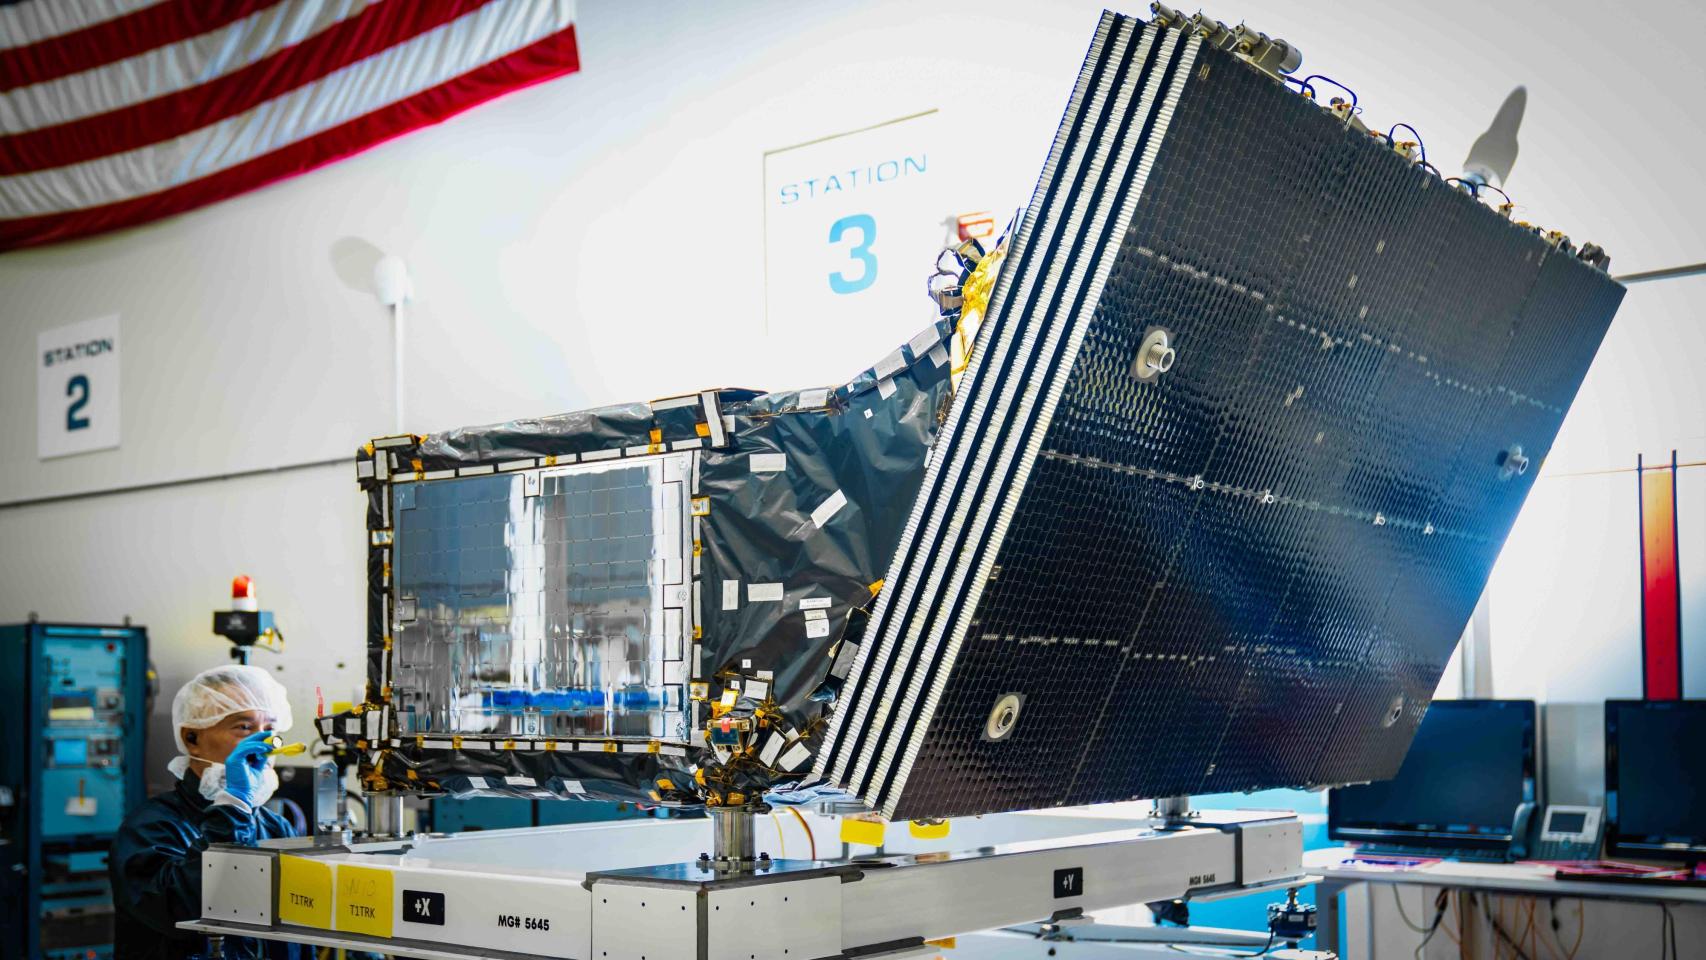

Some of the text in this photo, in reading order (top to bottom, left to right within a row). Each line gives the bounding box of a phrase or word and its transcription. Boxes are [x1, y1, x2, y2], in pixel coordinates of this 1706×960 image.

[780, 153, 927, 205] STATION
[828, 213, 879, 295] 3
[43, 338, 113, 367] STATION
[66, 373, 90, 432] 2
[1062, 873, 1075, 891] +Y
[414, 897, 431, 917] +X
[498, 914, 550, 932] MG# 5645
